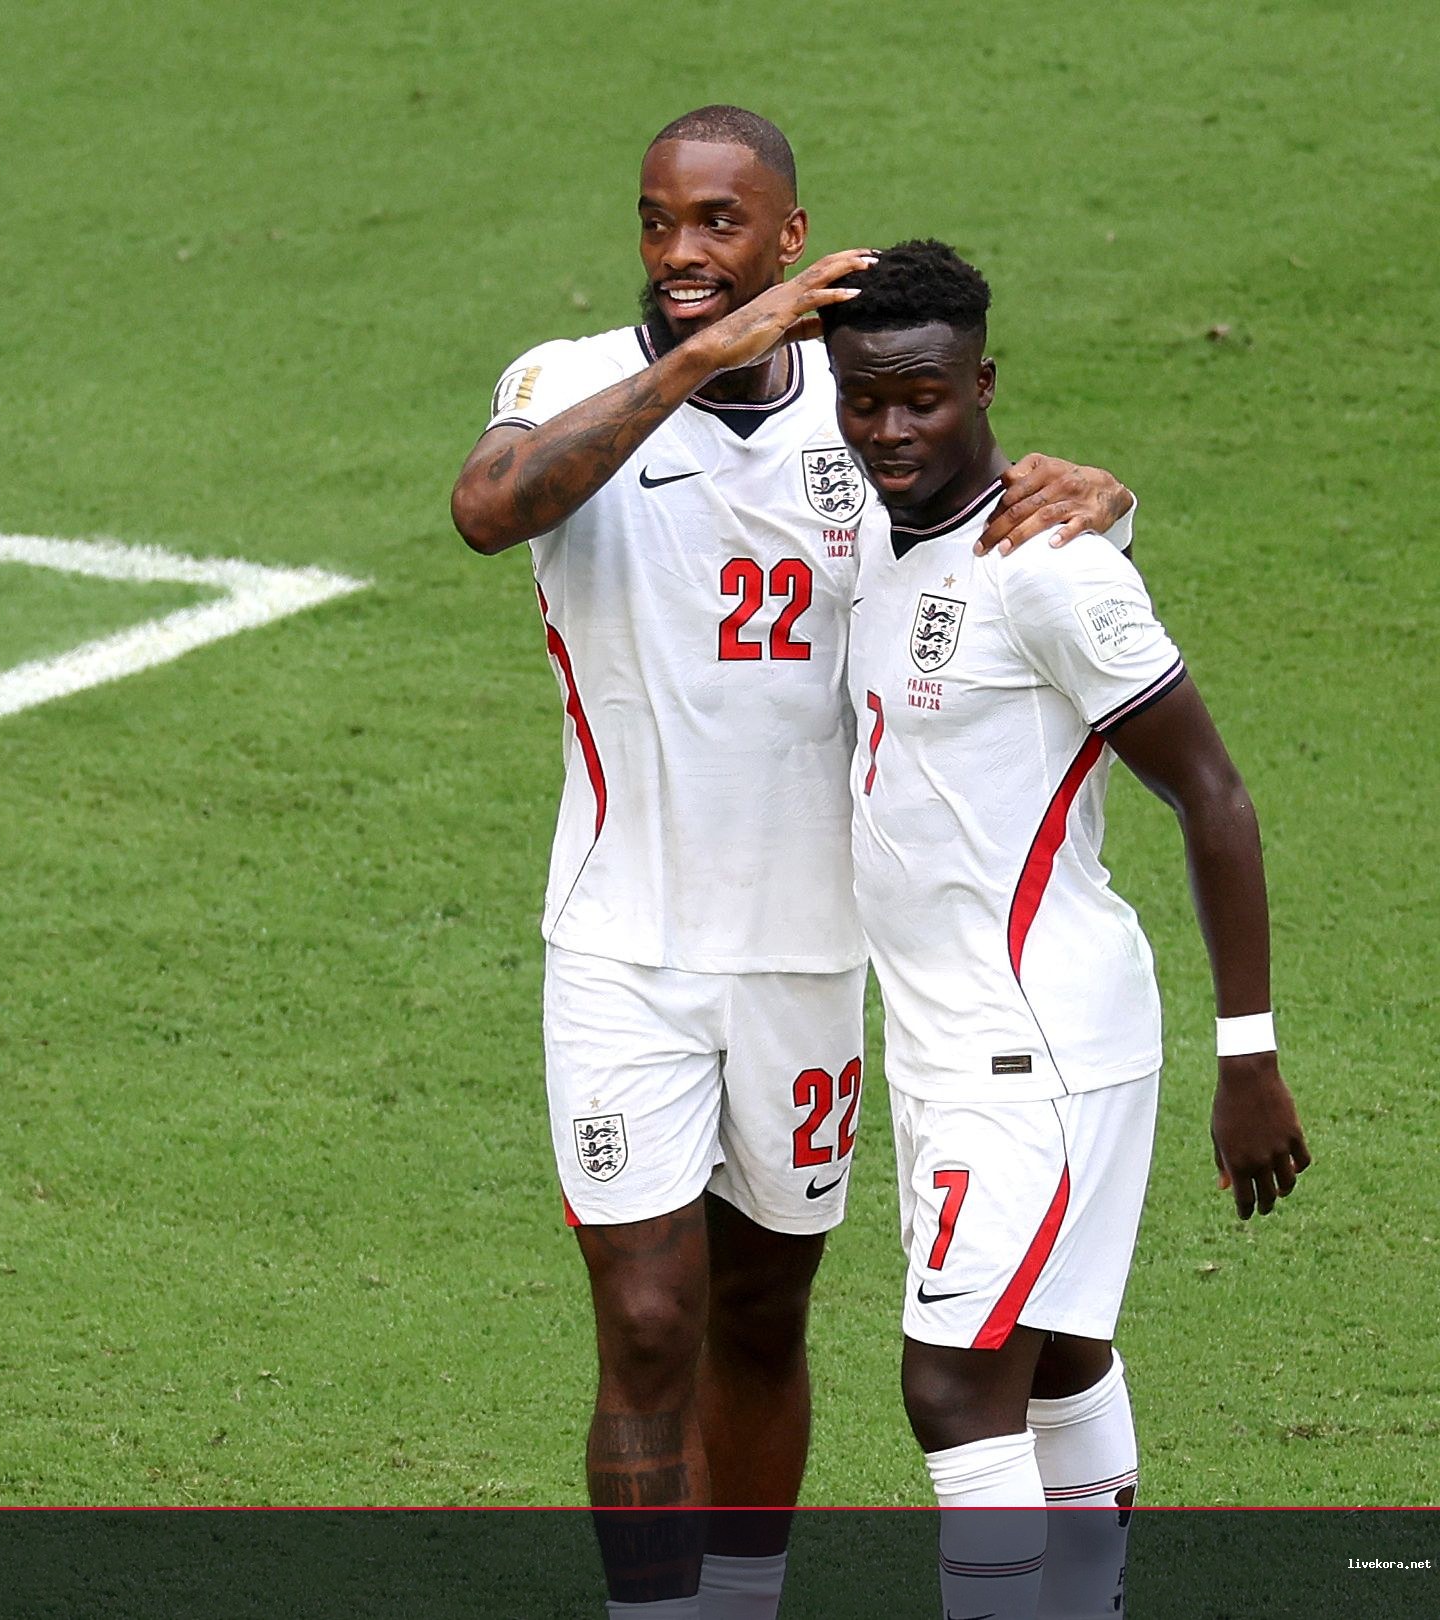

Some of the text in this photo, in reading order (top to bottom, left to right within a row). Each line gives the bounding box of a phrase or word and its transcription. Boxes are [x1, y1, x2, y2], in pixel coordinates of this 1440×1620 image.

[718, 557, 812, 660] 22
[1092, 604, 1128, 631] UNITES
[907, 678, 942, 695] FRANCE
[863, 689, 884, 797] 7
[793, 1056, 862, 1169] 22
[927, 1169, 970, 1271] 7
